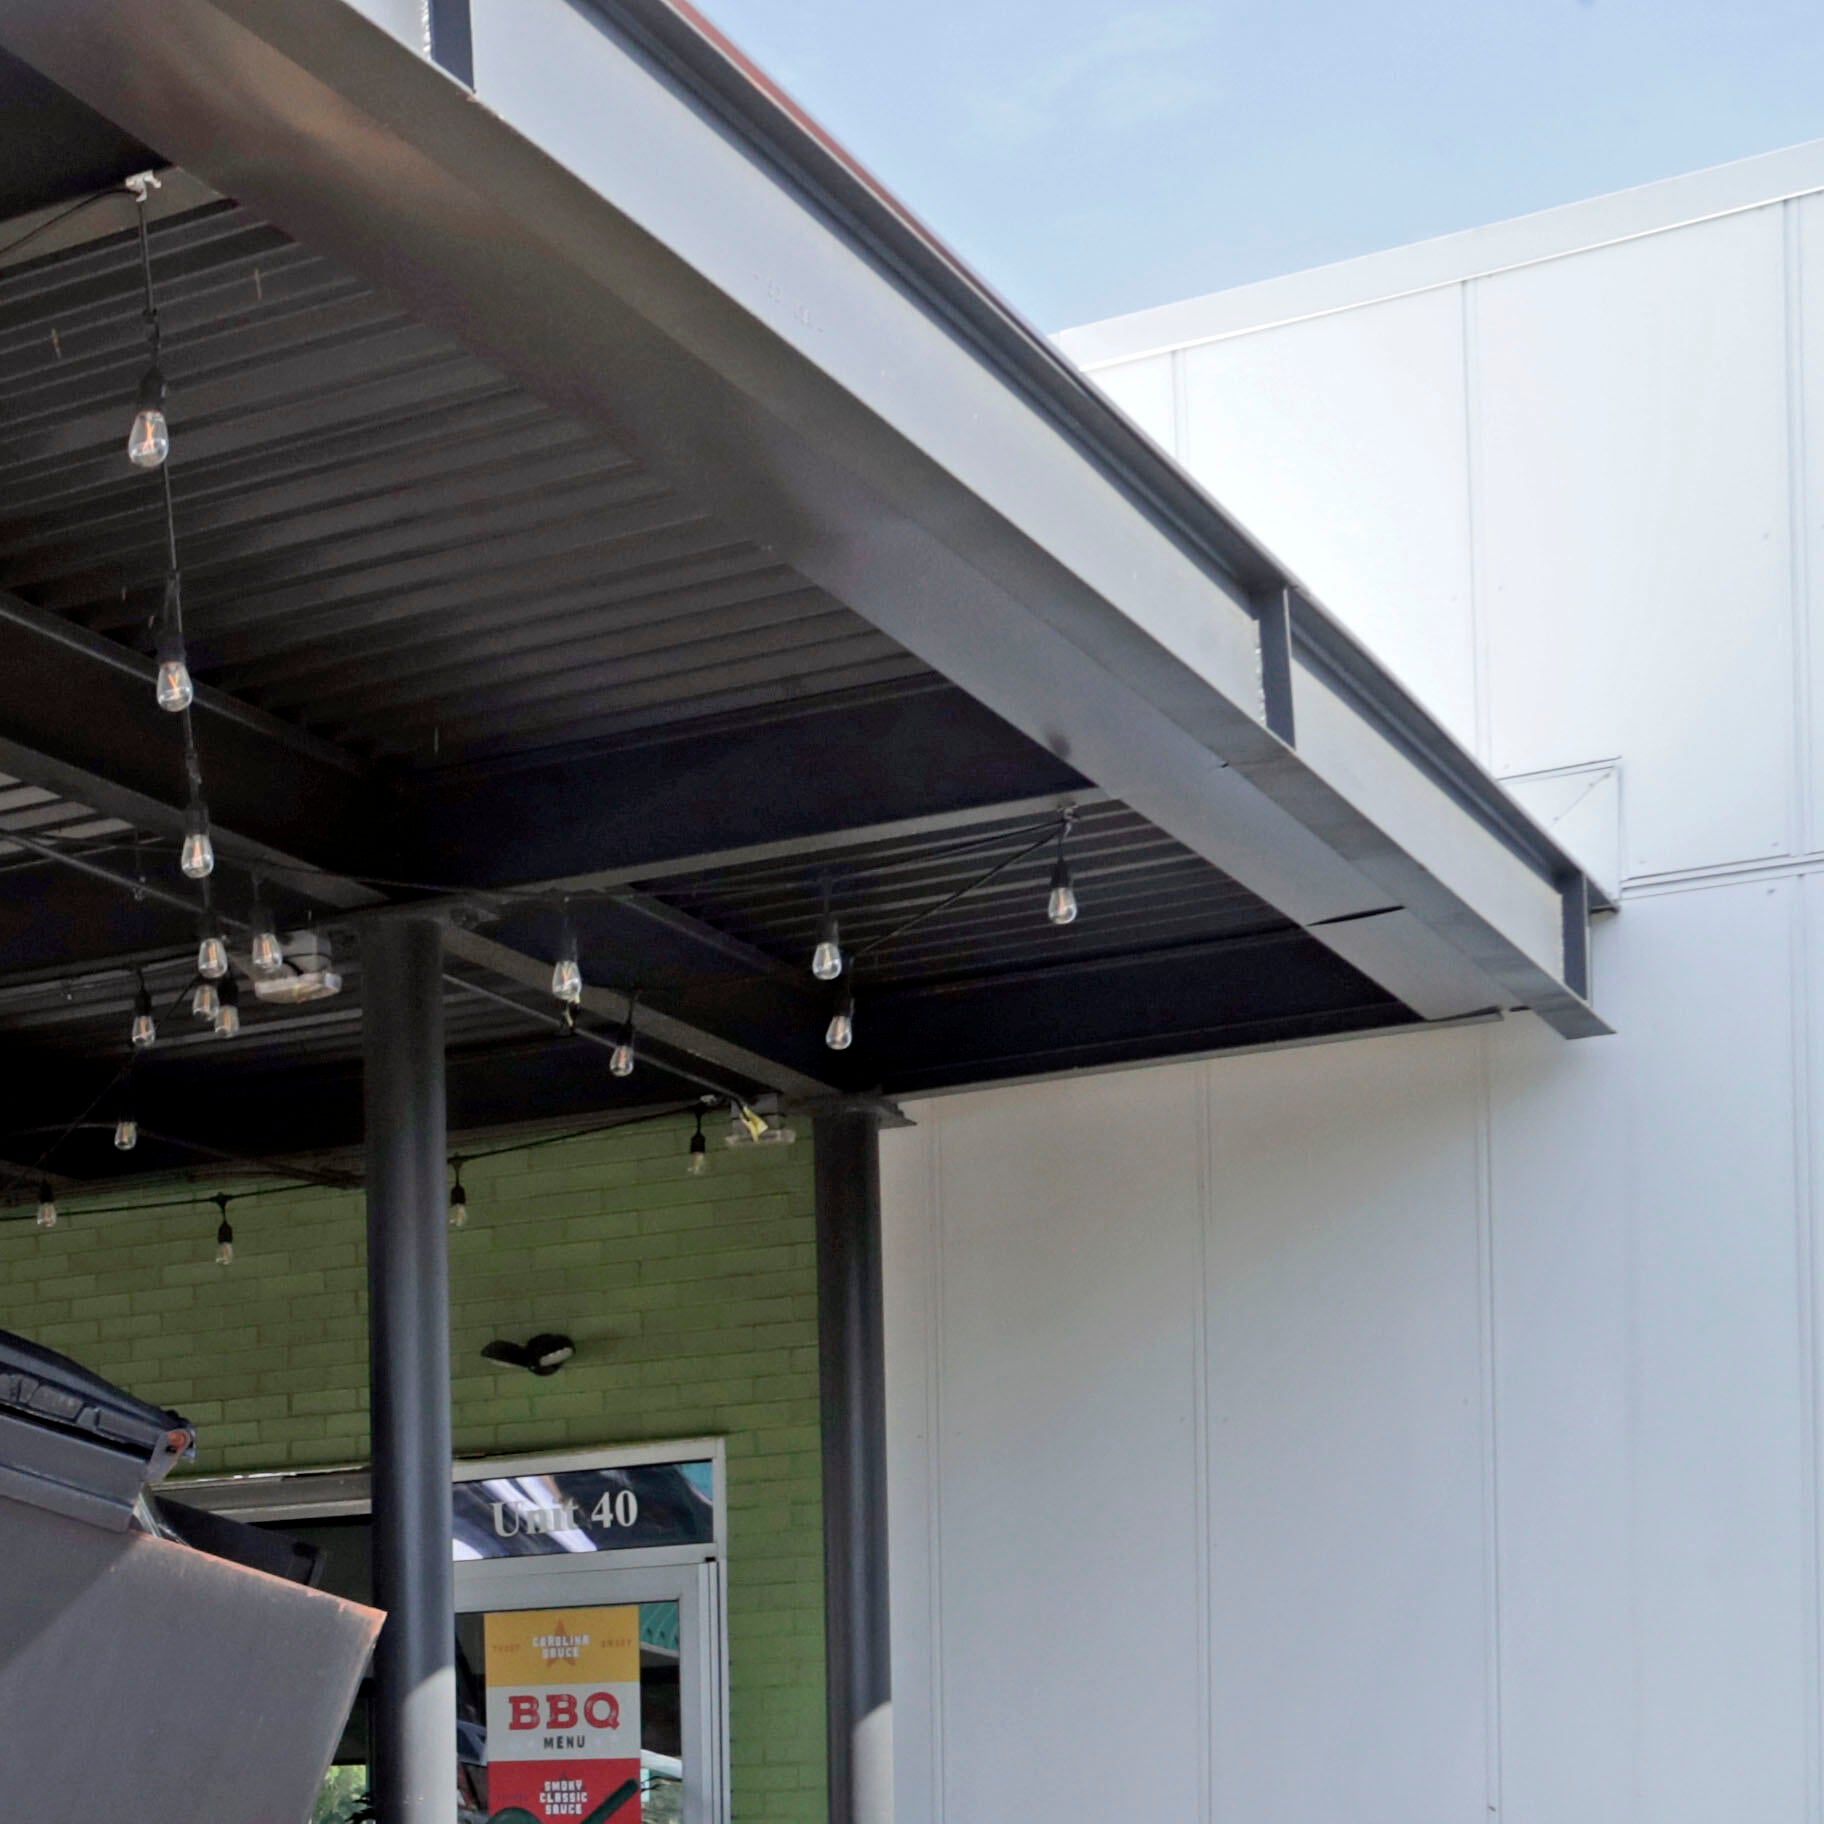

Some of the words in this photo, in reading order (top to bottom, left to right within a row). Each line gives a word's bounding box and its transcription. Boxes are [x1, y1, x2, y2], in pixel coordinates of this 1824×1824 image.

[491, 1498, 579, 1537] Unit
[591, 1490, 638, 1528] 40
[533, 1635, 590, 1646] CAROLINA
[543, 1647, 579, 1658] SAUCE
[509, 1692, 619, 1730] BBQ
[544, 1736, 585, 1749] MENU
[545, 1780, 582, 1791] SMOKY
[540, 1792, 587, 1803] CLASSIC
[545, 1804, 582, 1815] SAUCE
